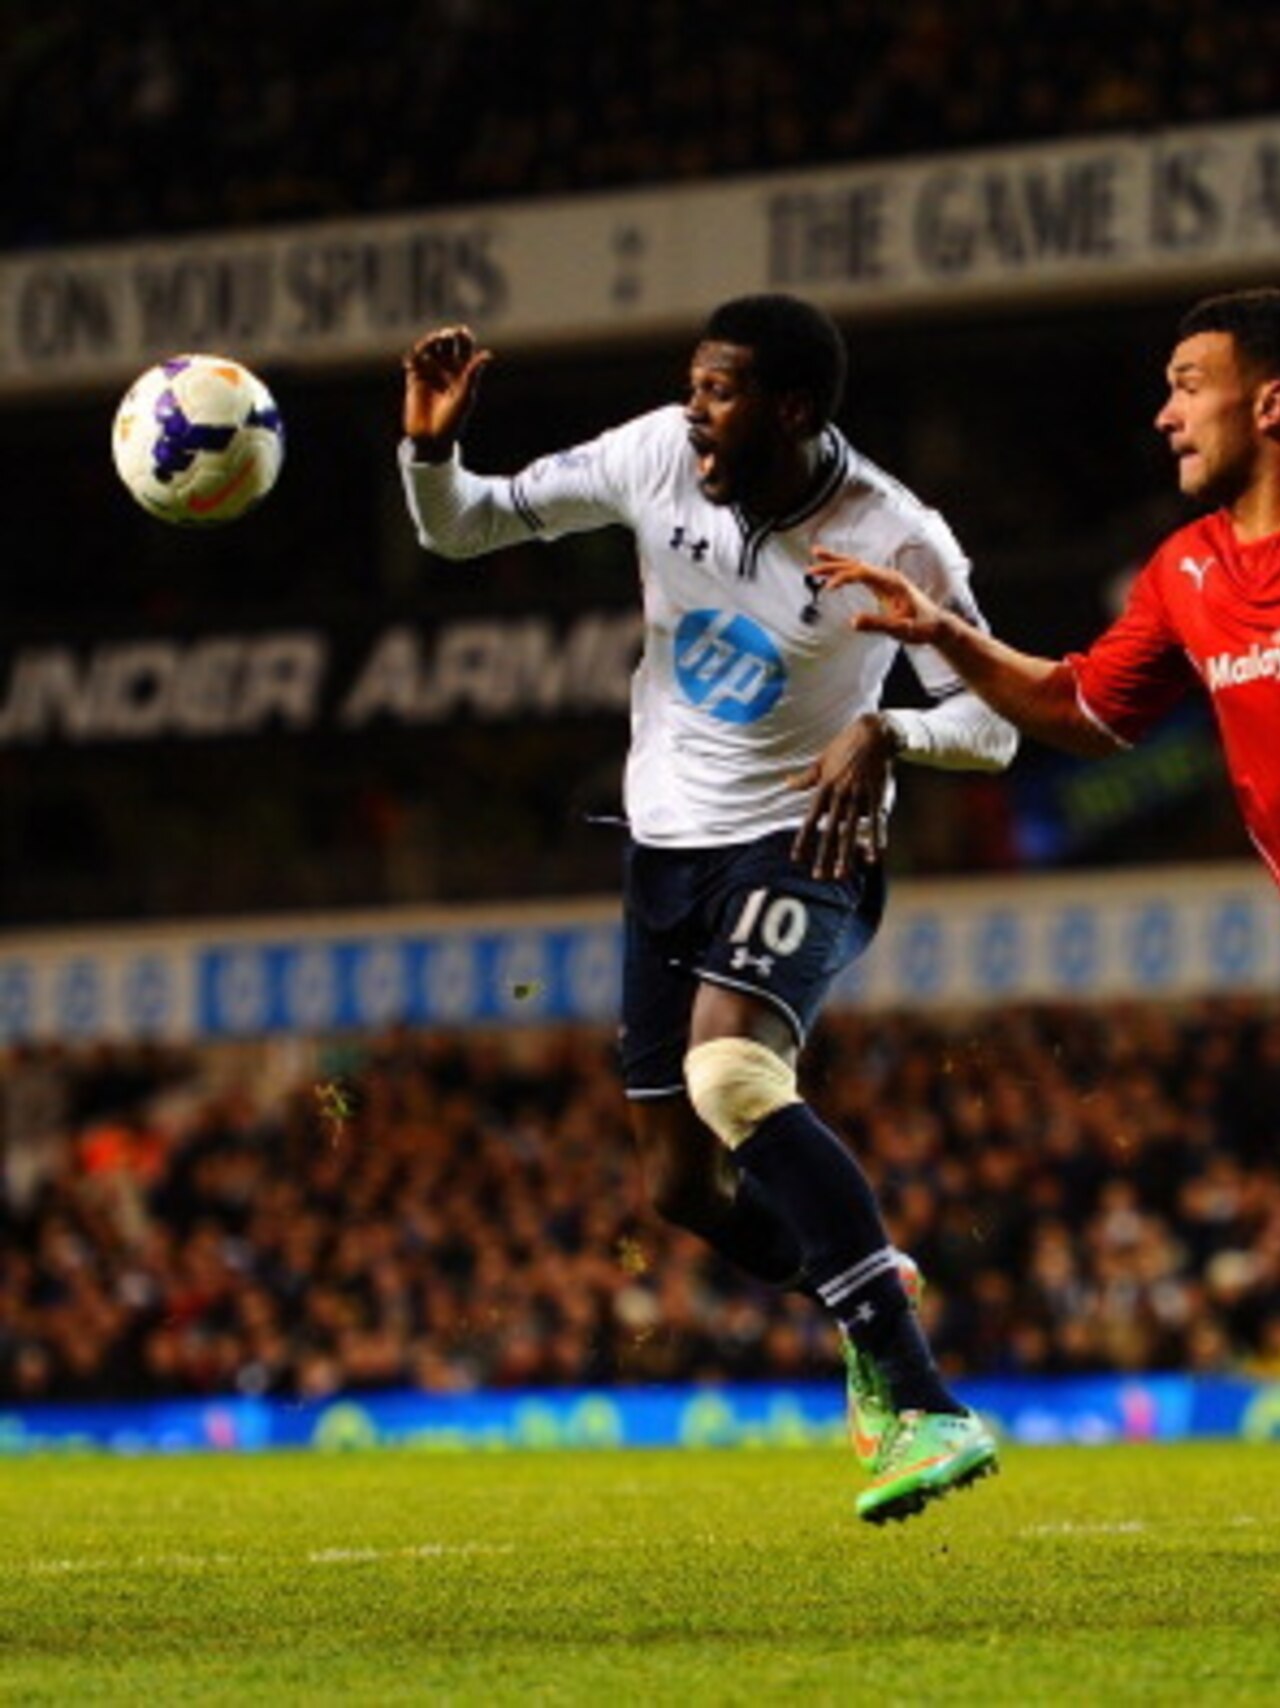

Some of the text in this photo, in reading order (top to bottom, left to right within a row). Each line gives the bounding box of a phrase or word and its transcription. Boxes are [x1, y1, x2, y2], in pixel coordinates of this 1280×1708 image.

[767, 181, 887, 286] THE
[911, 162, 1120, 274] GAME
[1148, 142, 1224, 252] IS
[17, 224, 508, 362] ON YOU SPURS
[677, 610, 772, 722] hp
[731, 887, 808, 957] 10
